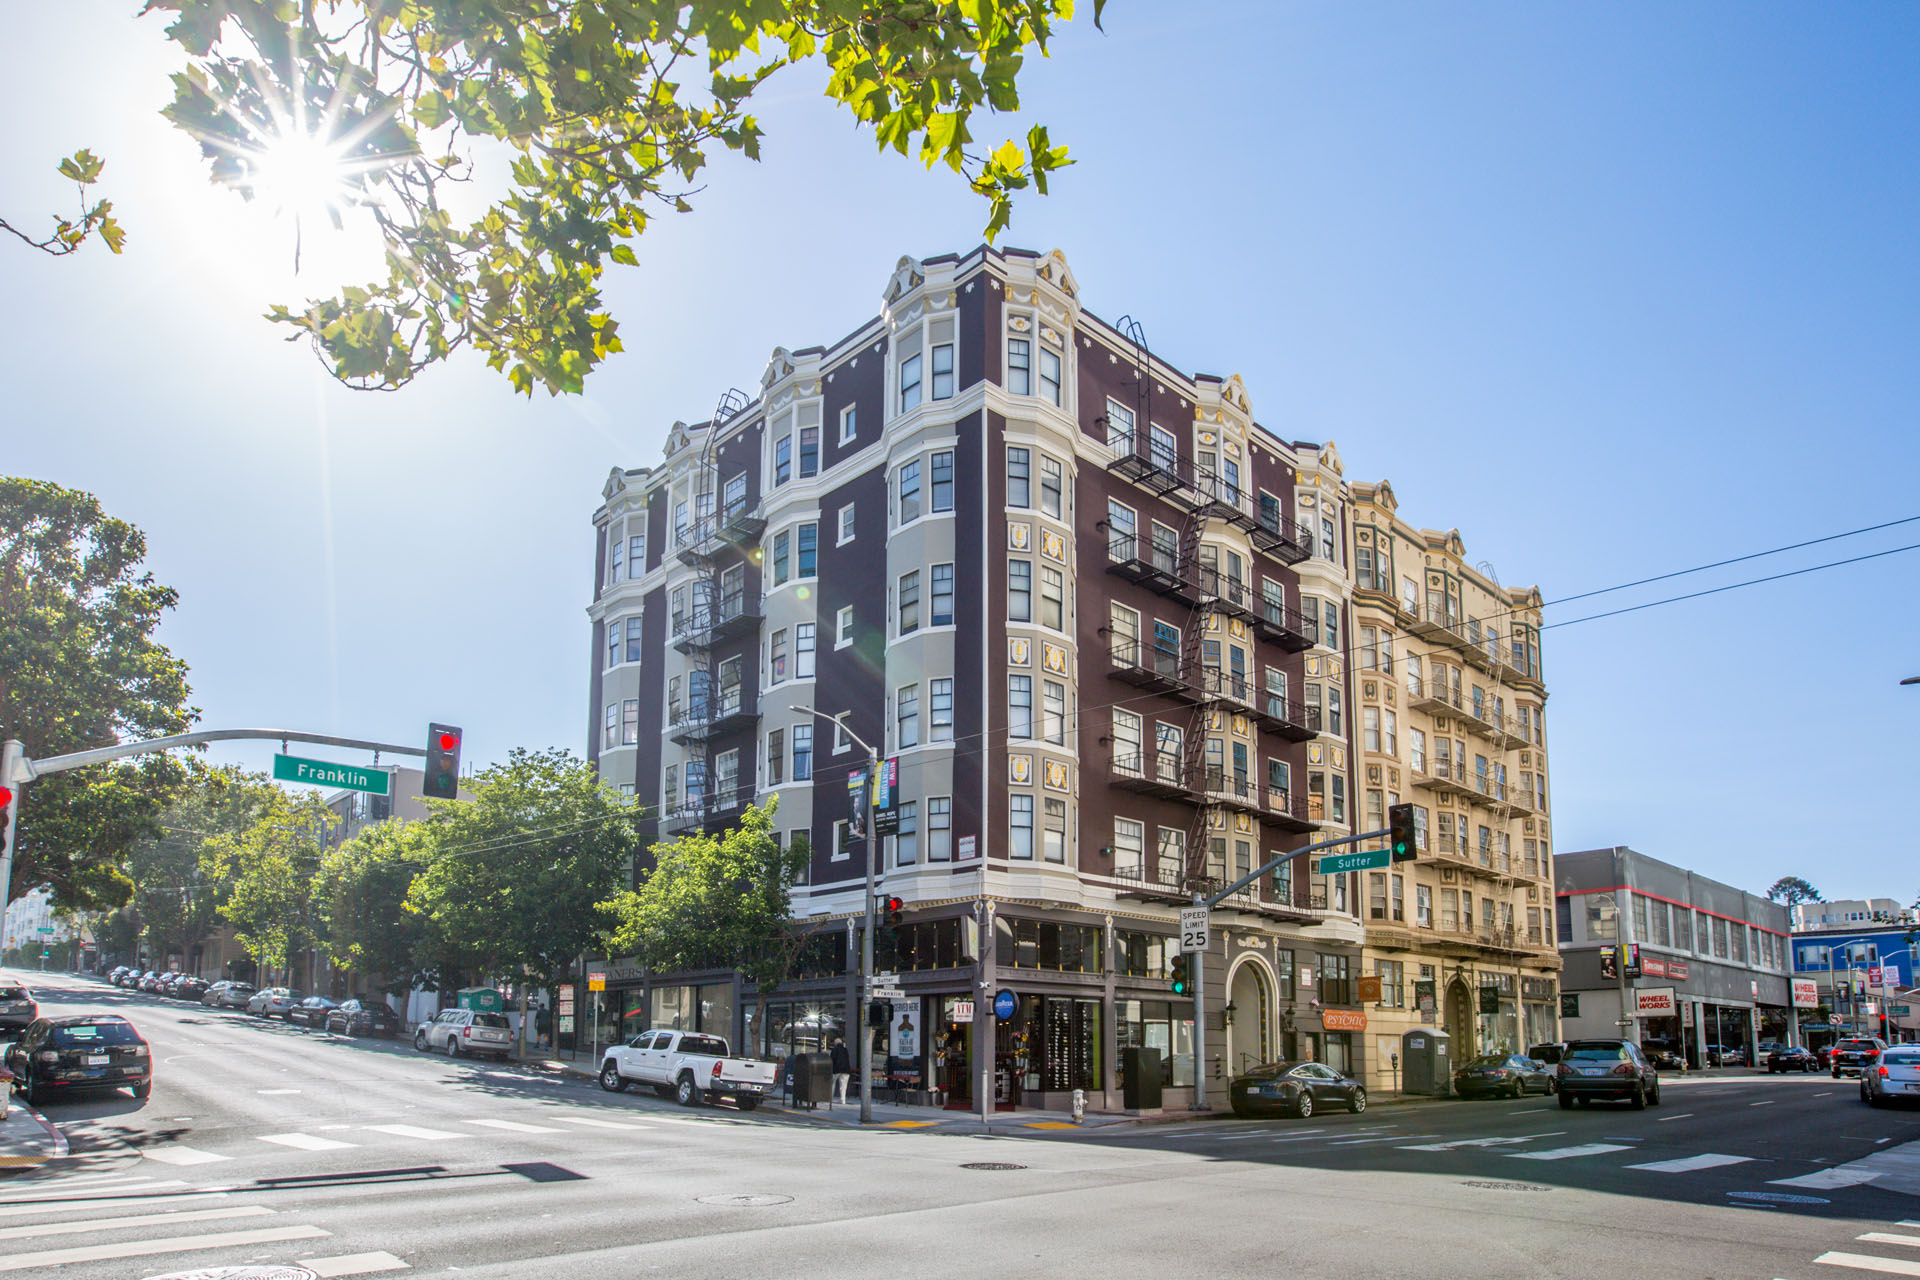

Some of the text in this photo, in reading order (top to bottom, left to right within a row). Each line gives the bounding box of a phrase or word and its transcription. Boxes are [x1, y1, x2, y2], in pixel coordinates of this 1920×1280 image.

[298, 764, 367, 786] Franklin
[1338, 857, 1371, 868] Sutter
[1183, 911, 1206, 919] SPEED
[1185, 921, 1204, 929] LIMIT
[1184, 932, 1206, 946] 25
[1794, 983, 1816, 993] WHEEL
[1794, 993, 1816, 1003] WORKS
[957, 1003, 972, 1014] ATM
[1326, 1014, 1366, 1027] PSYCHIC
